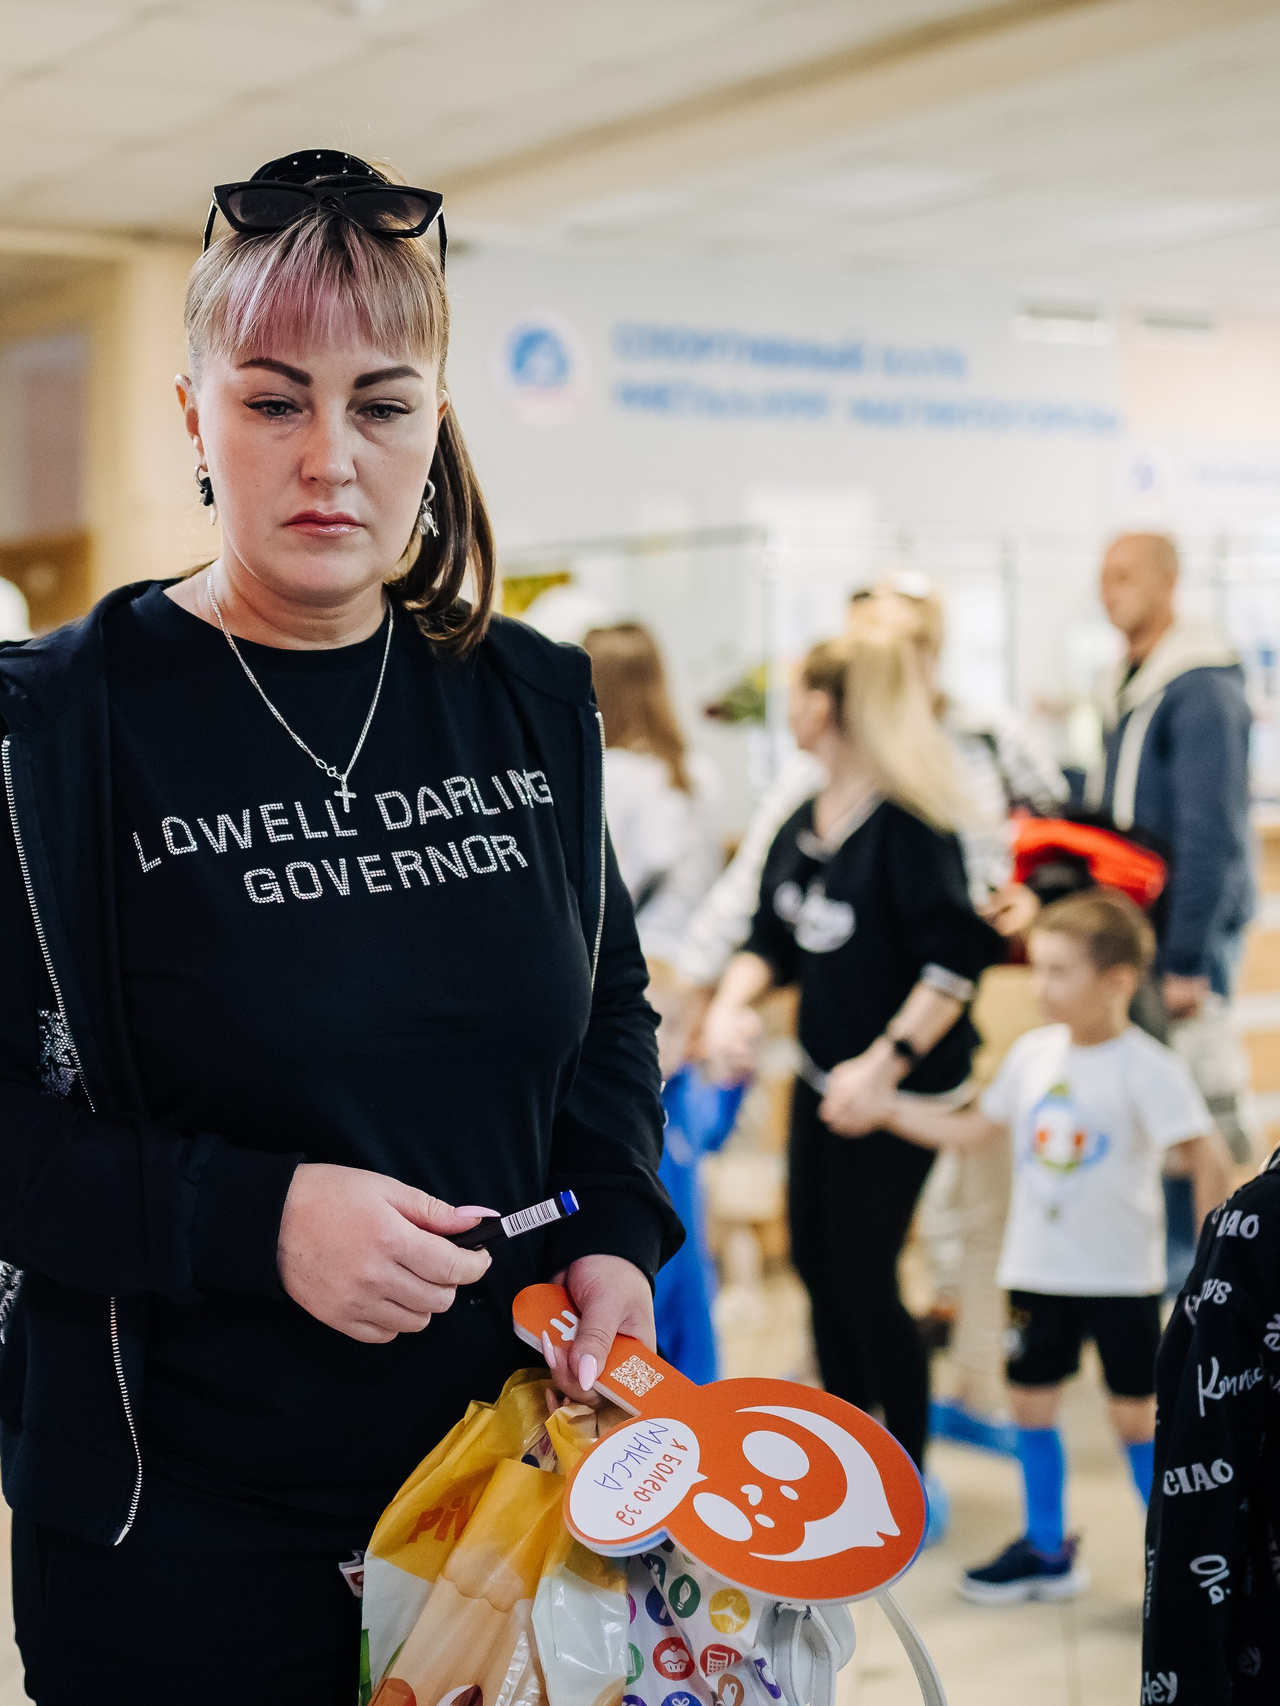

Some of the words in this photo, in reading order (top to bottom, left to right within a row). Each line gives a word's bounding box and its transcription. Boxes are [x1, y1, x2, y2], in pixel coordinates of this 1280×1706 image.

[132, 800, 357, 873] LOWELL
[375, 769, 554, 830] DARLING
[243, 834, 528, 904] GOVERNOR
[592, 1419, 670, 1491] МАКСА
[1163, 1458, 1234, 1496] CIAO
